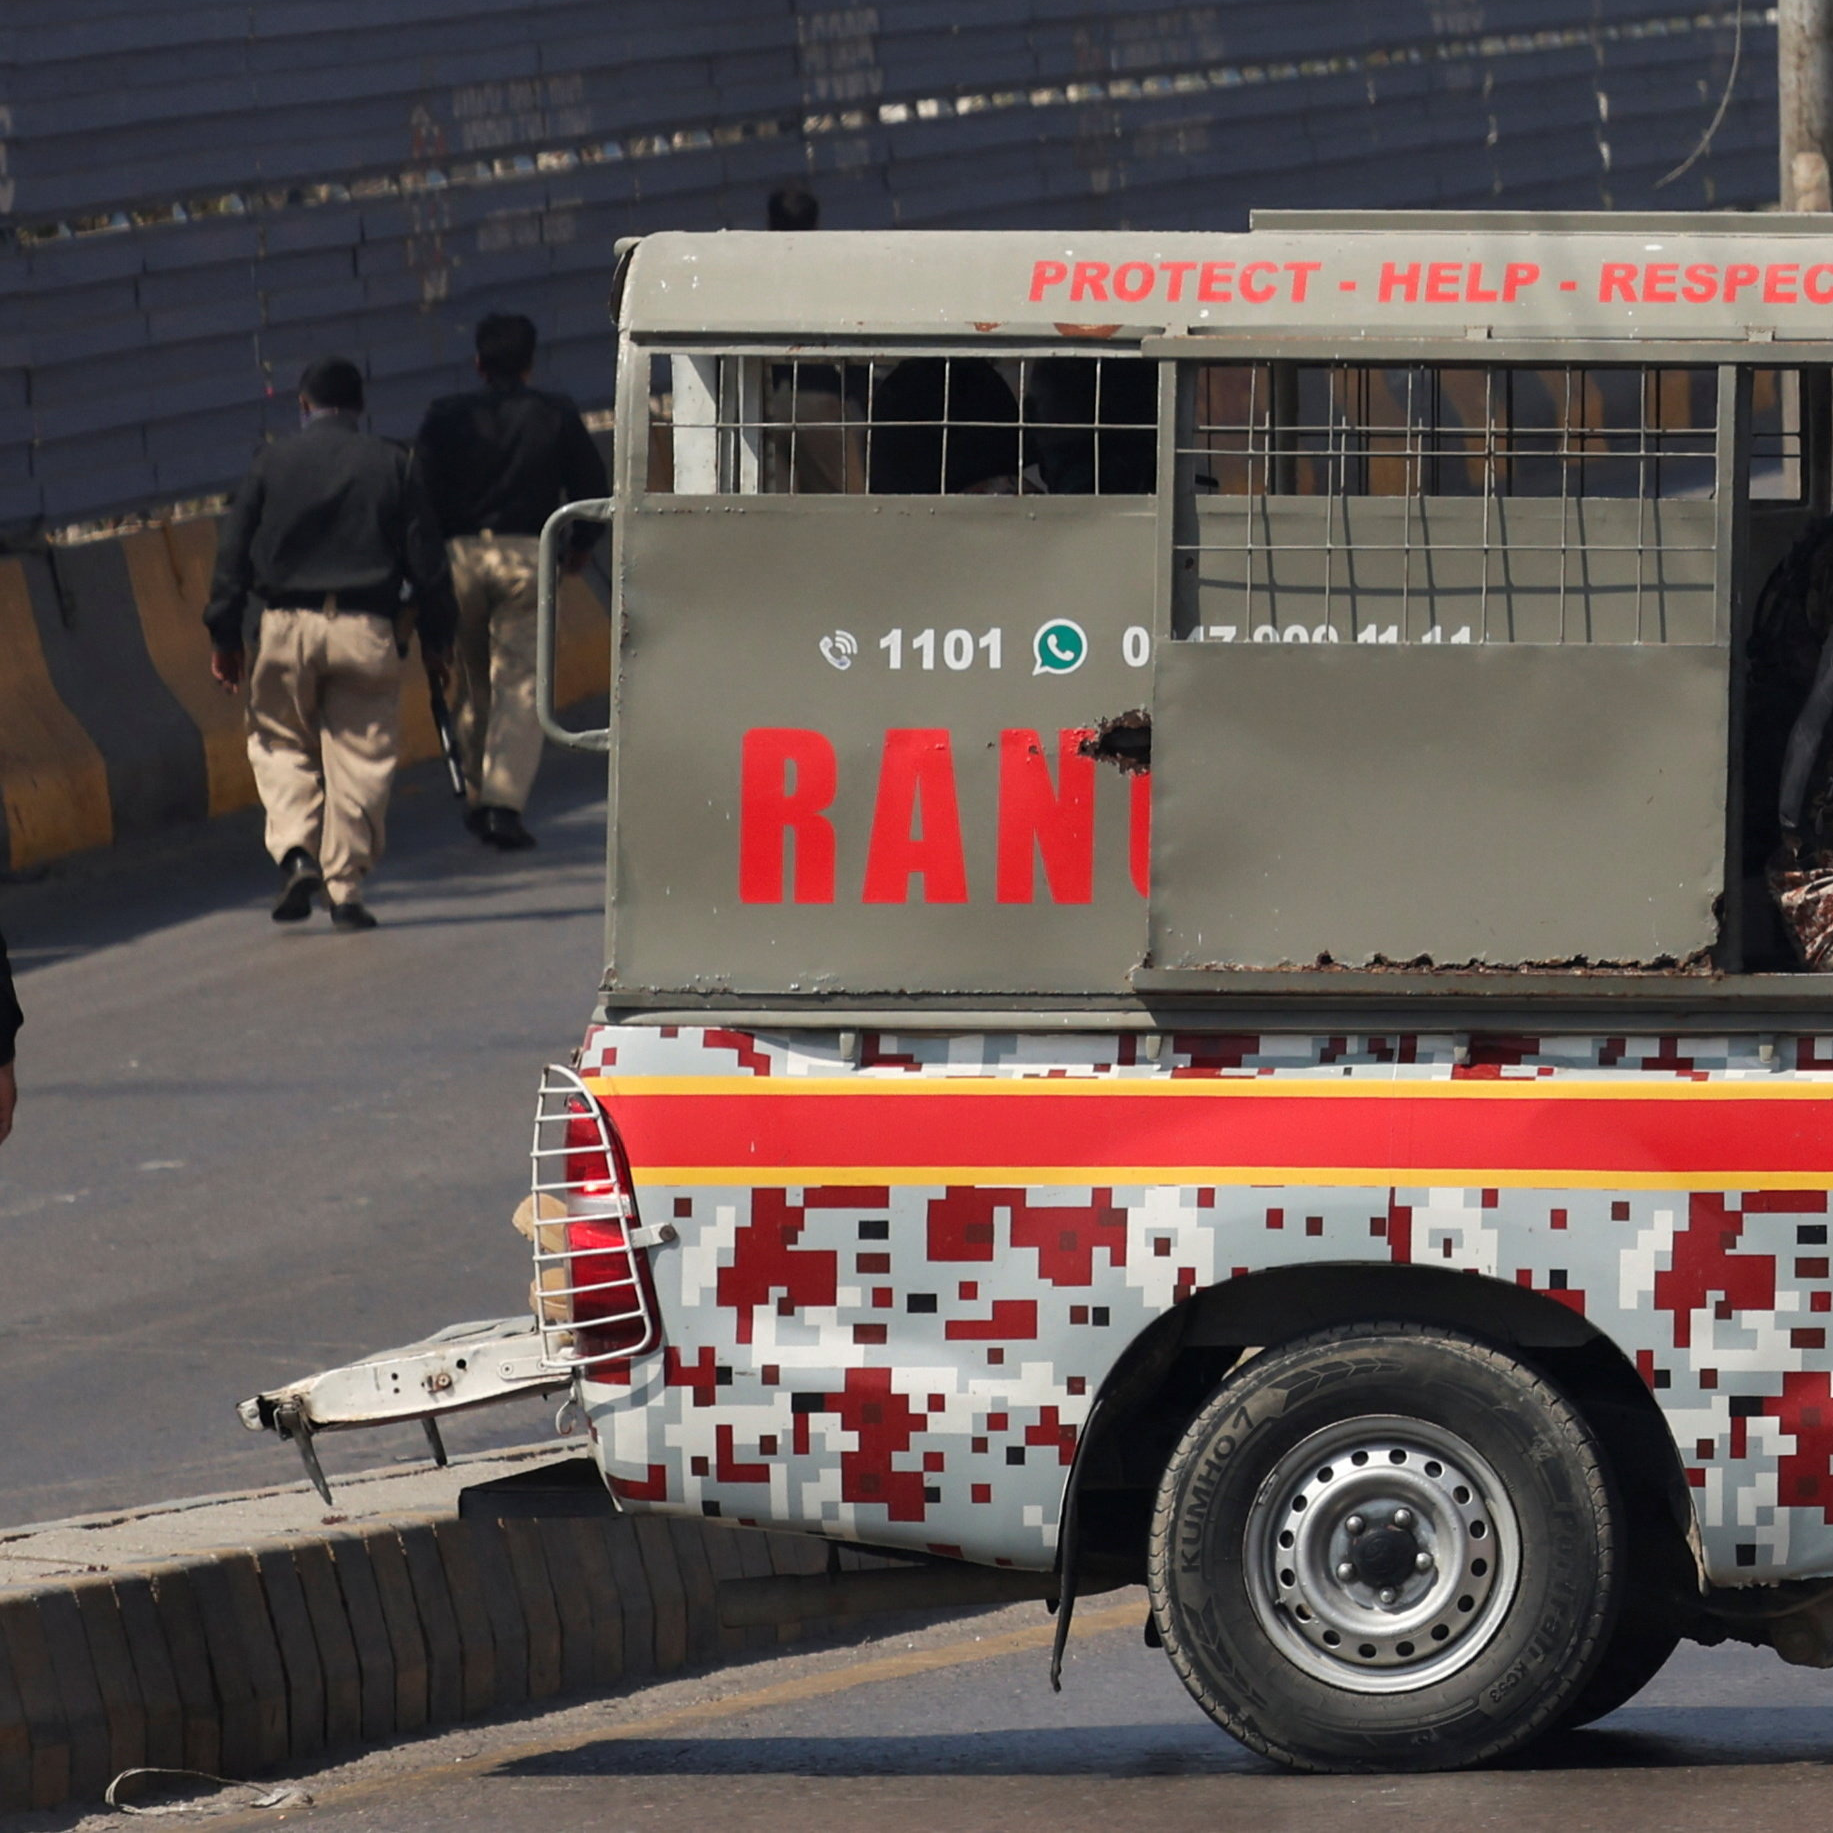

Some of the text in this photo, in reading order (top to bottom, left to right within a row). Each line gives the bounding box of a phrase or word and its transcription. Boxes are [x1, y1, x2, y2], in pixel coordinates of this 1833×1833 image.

[1029, 261, 1323, 305] PROTECT
[1378, 262, 1541, 304] HELP
[879, 627, 1002, 670] 1101
[739, 727, 1153, 906] RAN
[1180, 1434, 1237, 1574] KUMHO
